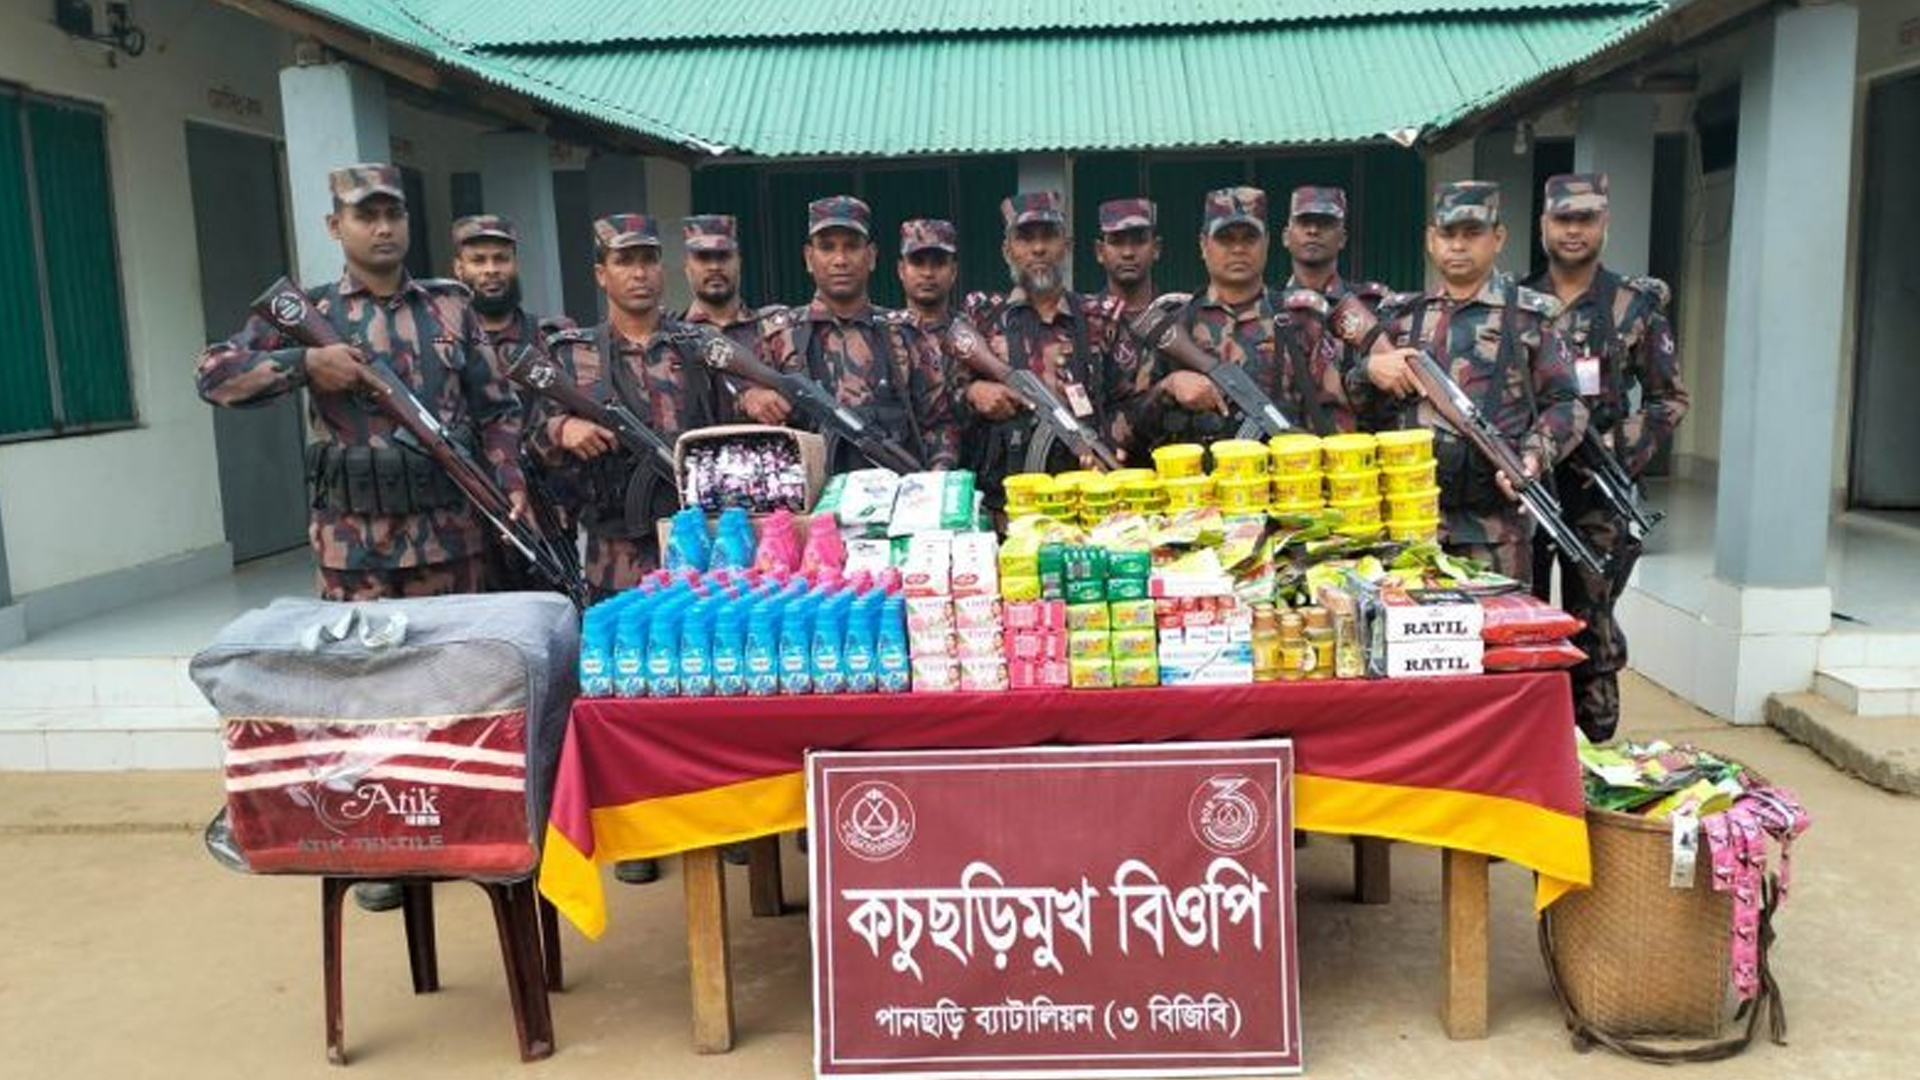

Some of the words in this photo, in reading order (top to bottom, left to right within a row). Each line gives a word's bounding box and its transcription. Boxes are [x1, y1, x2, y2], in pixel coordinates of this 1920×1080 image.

[1403, 620, 1468, 635] RATIL
[1405, 657, 1470, 672] RATIL
[340, 783, 439, 819] Atik
[841, 861, 1100, 982] কচুছড়িমুখ
[1109, 857, 1269, 956] বিওপি
[875, 997, 967, 1040] পানছড়ি
[971, 995, 1094, 1035] ব্যাটালিয়ন
[1104, 1000, 1139, 1039] (৩
[1148, 993, 1242, 1038] বিজিবি)
